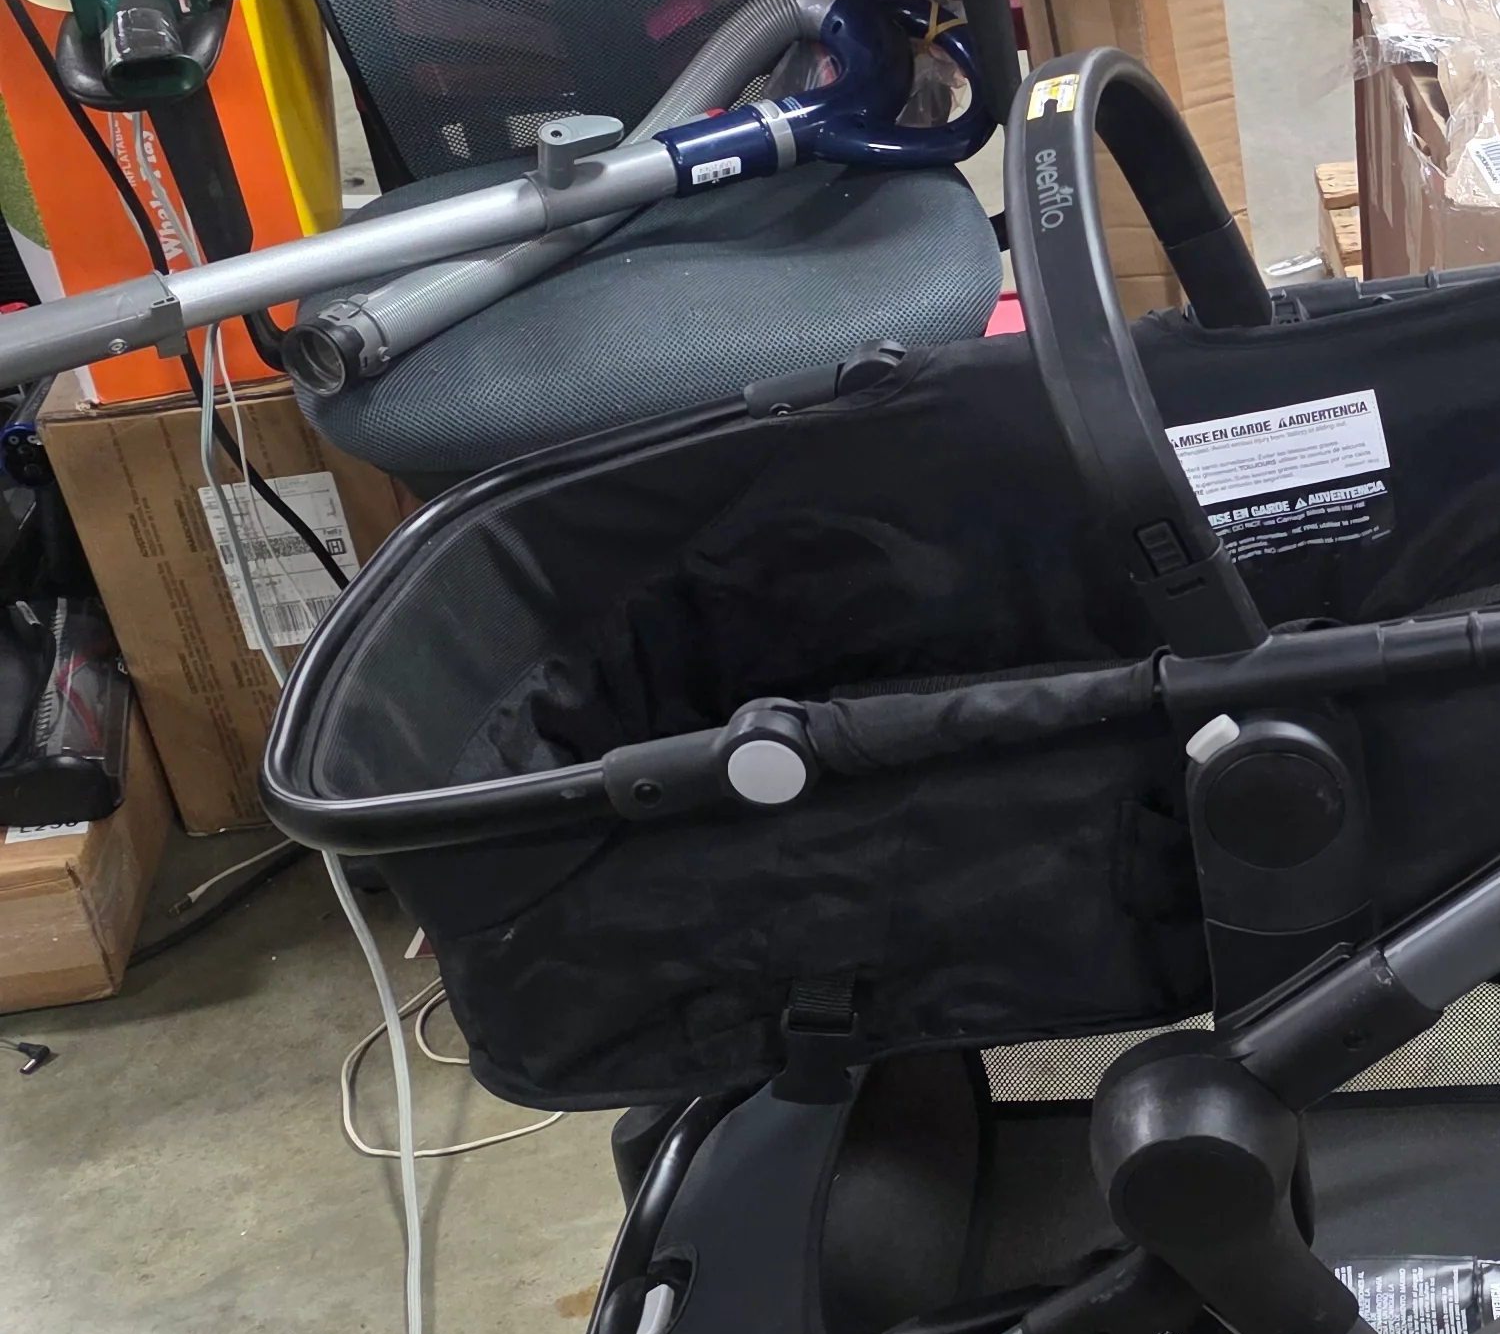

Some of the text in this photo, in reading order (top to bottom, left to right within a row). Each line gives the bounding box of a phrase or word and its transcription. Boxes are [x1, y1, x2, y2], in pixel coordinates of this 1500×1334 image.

[1035, 149, 1074, 233] evenflo
[1179, 401, 1368, 447] MISE EN GARDE ADVERTENCIA
[1250, 500, 1291, 517] GARDE
[1308, 480, 1386, 505] ADVERTENCIA
